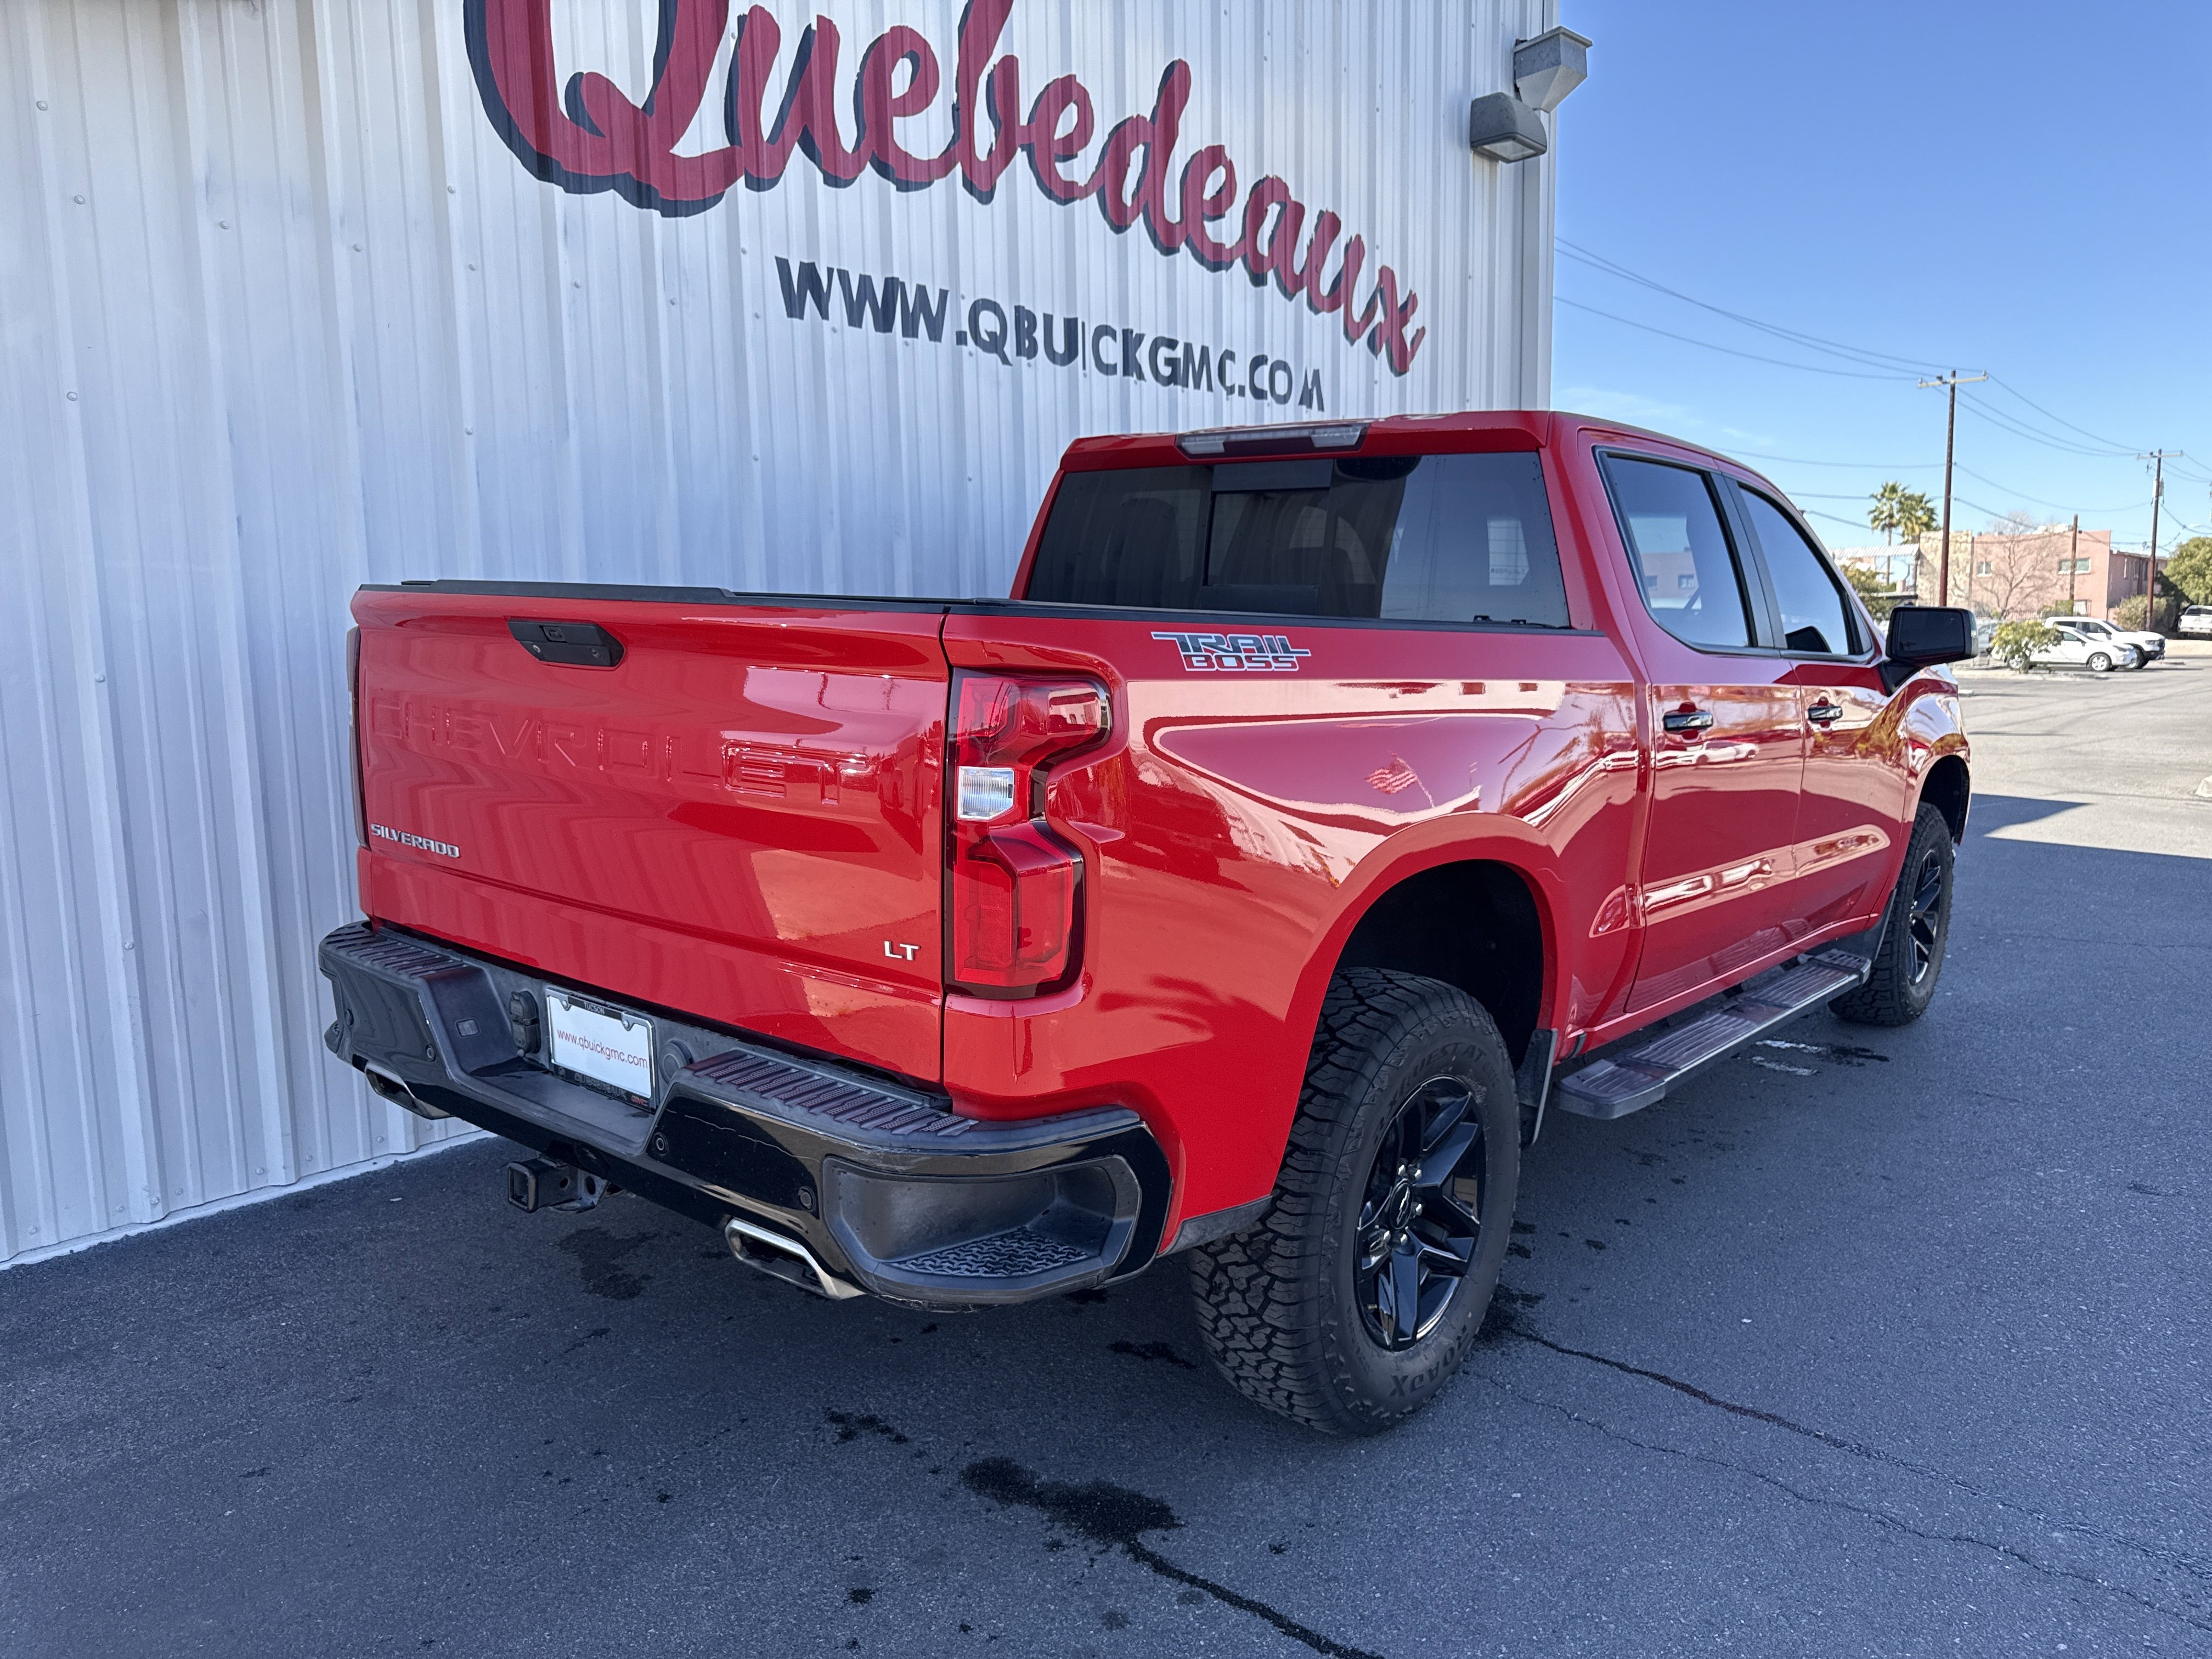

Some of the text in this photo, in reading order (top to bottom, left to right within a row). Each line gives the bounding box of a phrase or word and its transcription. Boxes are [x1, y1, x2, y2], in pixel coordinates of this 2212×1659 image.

[775, 256, 1325, 413] WWW.QBUICKGMC.COM
[1150, 631, 1311, 657] TRAIL
[1182, 653, 1299, 672] BOSS
[371, 696, 870, 805] CHEVROLET
[370, 822, 460, 858] SILVERADO
[883, 940, 920, 961] LT
[583, 1001, 606, 1015] TUCSON
[556, 1028, 648, 1069] www.qbuickgmc.com
